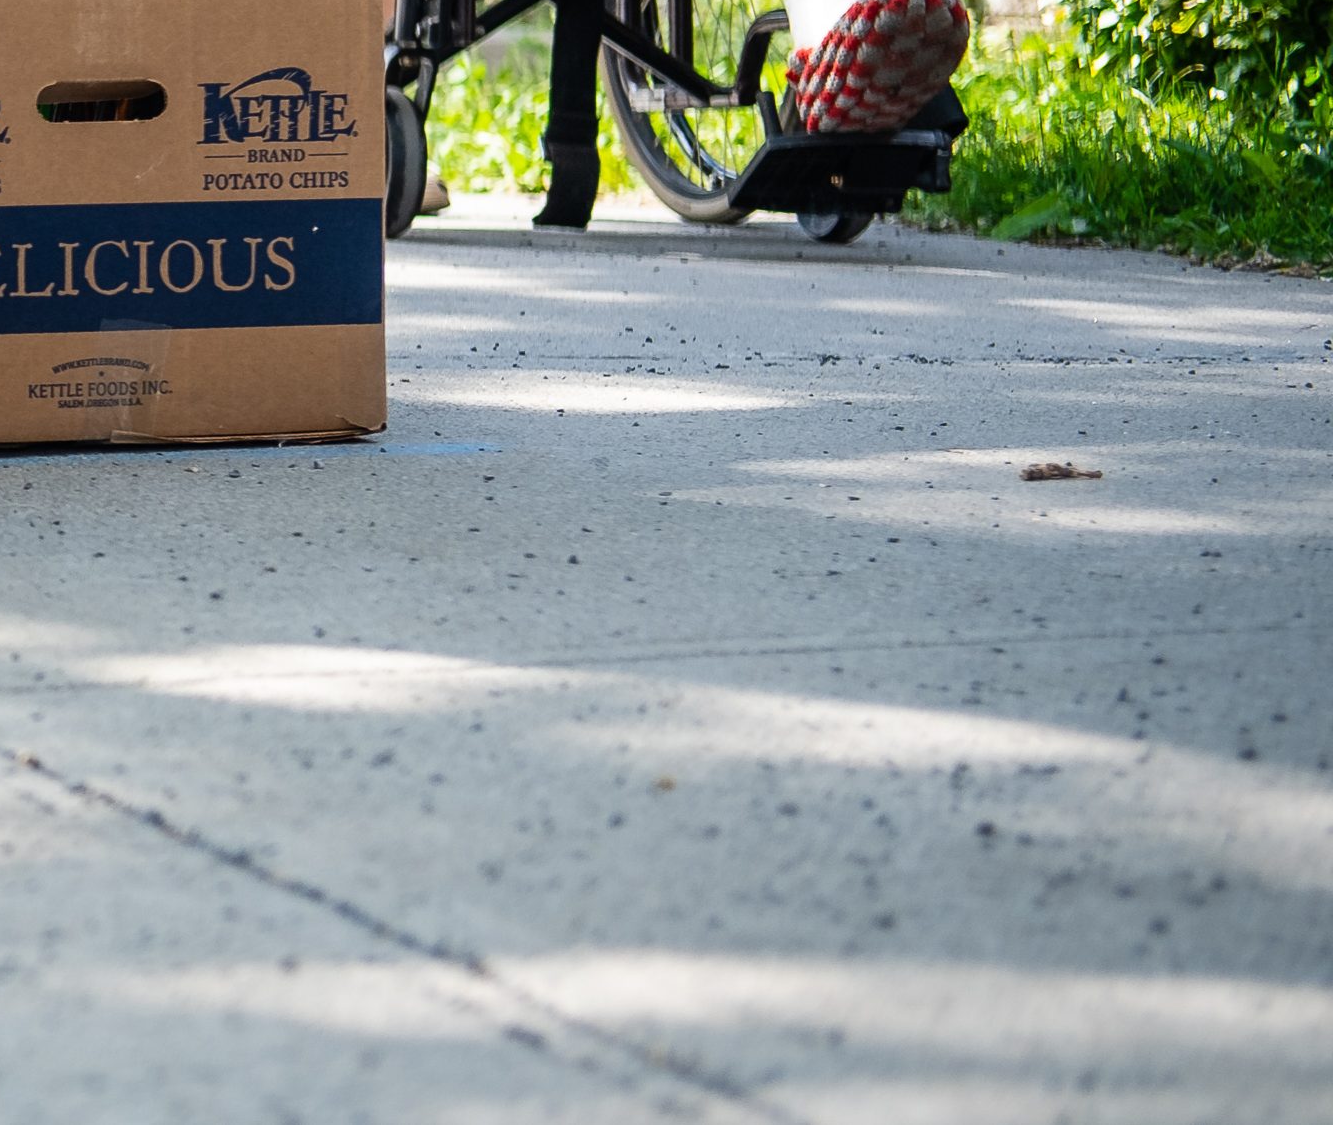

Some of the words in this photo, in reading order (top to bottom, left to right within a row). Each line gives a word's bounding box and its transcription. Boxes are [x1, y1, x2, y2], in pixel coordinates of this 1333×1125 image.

[196, 66, 358, 145] KETTLE
[246, 148, 306, 164] BRAND
[202, 172, 284, 191] POTATO
[288, 170, 350, 189] CHIPS
[27, 382, 84, 399] KETTLE
[87, 380, 139, 398] FOODS
[141, 379, 174, 396] INC.
